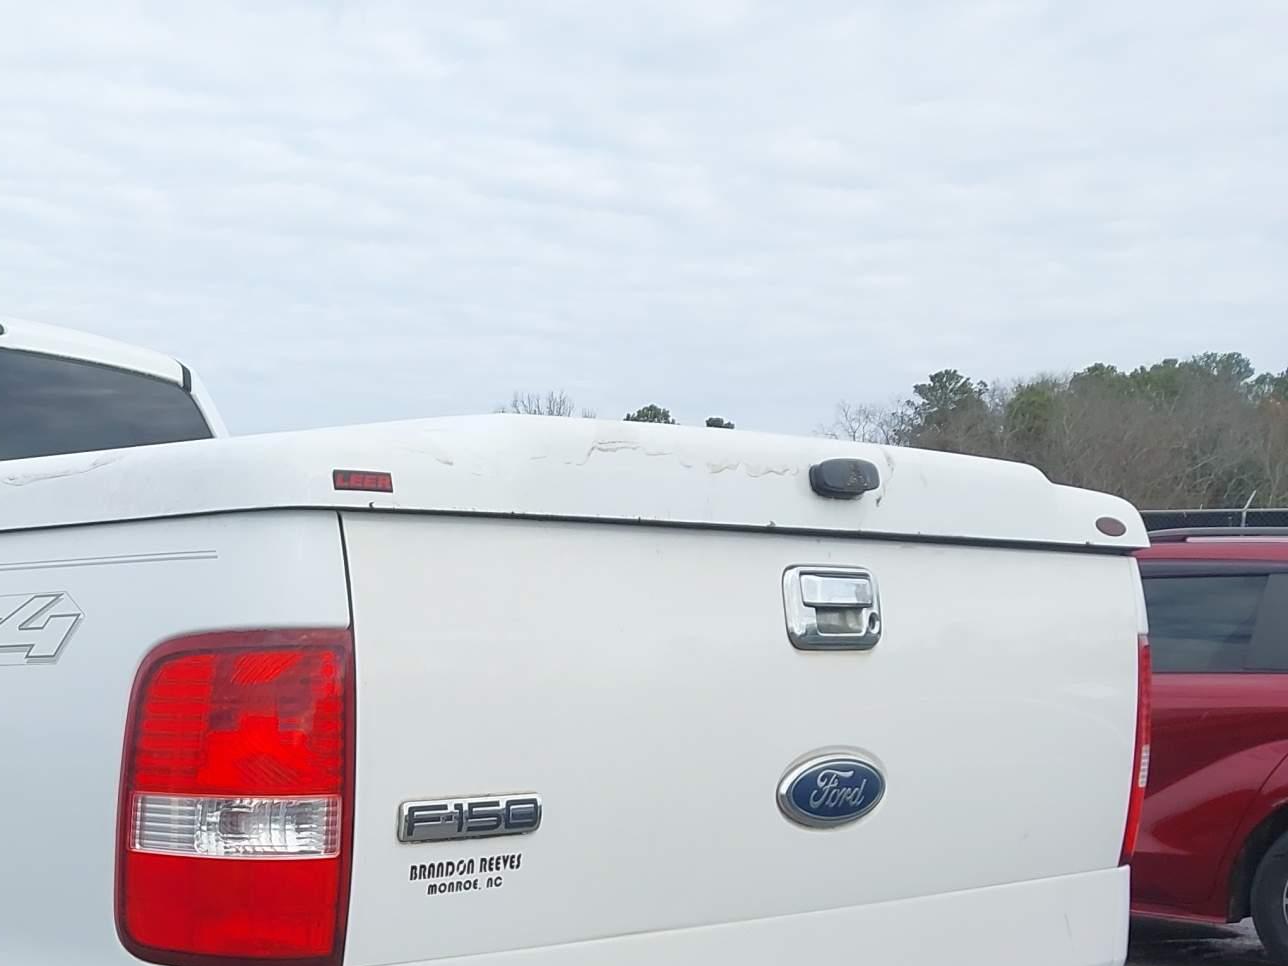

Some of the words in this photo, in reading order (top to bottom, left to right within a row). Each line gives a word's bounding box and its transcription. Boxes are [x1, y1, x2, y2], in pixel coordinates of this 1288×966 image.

[809, 769, 867, 808] Ford
[406, 798, 539, 836] F-150
[410, 859, 475, 881] BRANDON
[479, 853, 522, 873] REEVES
[486, 876, 503, 888] NC
